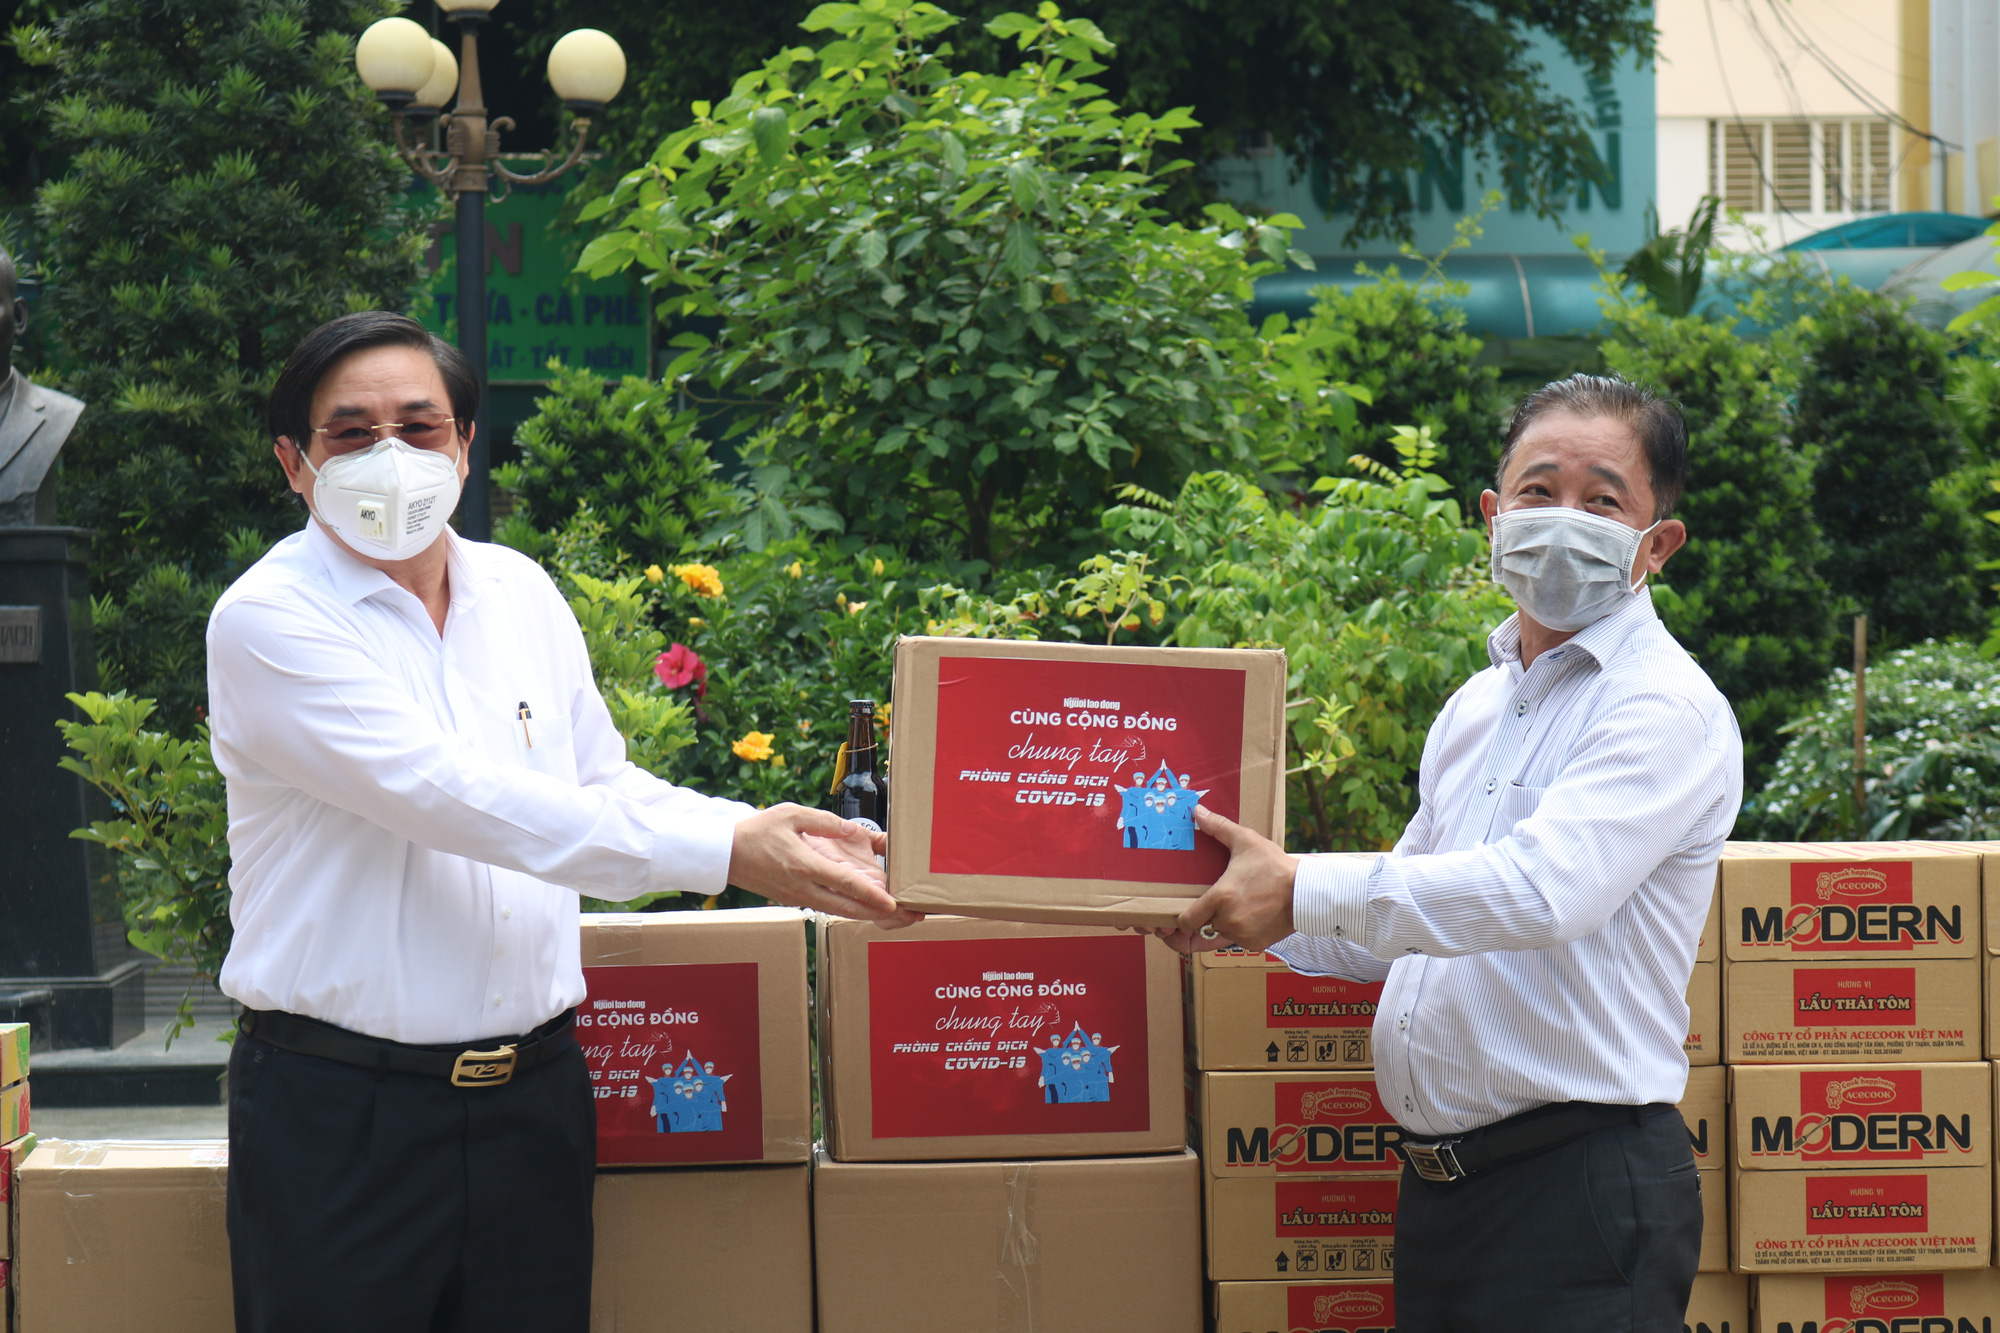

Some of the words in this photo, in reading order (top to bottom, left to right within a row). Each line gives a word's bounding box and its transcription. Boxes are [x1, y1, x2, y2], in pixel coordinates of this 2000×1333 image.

[360, 508, 376, 521] AKYO
[1010, 708, 1062, 726] CÙNG
[1066, 710, 1119, 730] CỘNG
[1123, 711, 1178, 732] ĐỒNG
[1008, 732, 1083, 771] chung
[1089, 737, 1130, 774] tay
[959, 768, 1012, 783] PHÒNG
[1017, 769, 1069, 786] CHỐNG
[1074, 775, 1110, 789] DỊCH
[1014, 789, 1107, 807] COVID-19
[1851, 868, 1887, 880] happiness
[1741, 904, 1964, 946] MODERN
[934, 983, 982, 999] CÙNG
[985, 982, 1034, 1000] CỘNG
[1037, 979, 1087, 997] ĐỒNG
[1272, 998, 1306, 1017] LẨU
[1307, 1001, 1349, 1016] THÁI
[1799, 992, 1833, 1011] LẨU
[1835, 995, 1875, 1011] THÁI
[1877, 994, 1912, 1010] TÔM
[596, 1011, 646, 1029] CỘNG
[650, 1007, 699, 1025] ĐỒNG
[935, 1005, 1003, 1038] chung
[1008, 1006, 1045, 1037] tay
[1686, 1034, 1701, 1043] AM
[1742, 1030, 1775, 1041] CÔNG
[1777, 1032, 1793, 1041] TY
[1795, 1027, 1812, 1041] CỔ
[1815, 1027, 1847, 1040] PHẦN
[1850, 1030, 1906, 1040] ACECOOK
[1908, 1029, 1935, 1041] VIỆT
[1938, 1030, 1964, 1039] NAM
[620, 1035, 657, 1066] tay
[892, 1041, 940, 1054] PHÒNG
[945, 1038, 992, 1052] CHỐNG
[996, 1040, 1029, 1054] DỊCH
[944, 1056, 1028, 1071] COVID-19
[608, 1069, 641, 1083] DỊCH
[1860, 1077, 1896, 1089] happiness
[592, 1085, 639, 1099] ID-19
[1335, 1087, 1372, 1100] happiness
[1751, 1112, 1974, 1156] MODERN
[1226, 1123, 1406, 1167] MODER
[1281, 1206, 1315, 1226] LẨU
[1317, 1210, 1357, 1225] THÁI
[1359, 1210, 1394, 1225] TÔM
[1811, 1200, 1845, 1219] LẨU
[1846, 1202, 1887, 1218] THÁI
[1889, 1202, 1924, 1217] TÔM
[1755, 1239, 1787, 1250] CÔNG
[1790, 1240, 1805, 1249] TY
[1807, 1236, 1824, 1249] CỔ
[1827, 1235, 1860, 1248] PHẦN
[1863, 1238, 1918, 1248] ACECOOK
[1920, 1235, 1947, 1248] VIỆT
[1950, 1237, 1976, 1246] NAM
